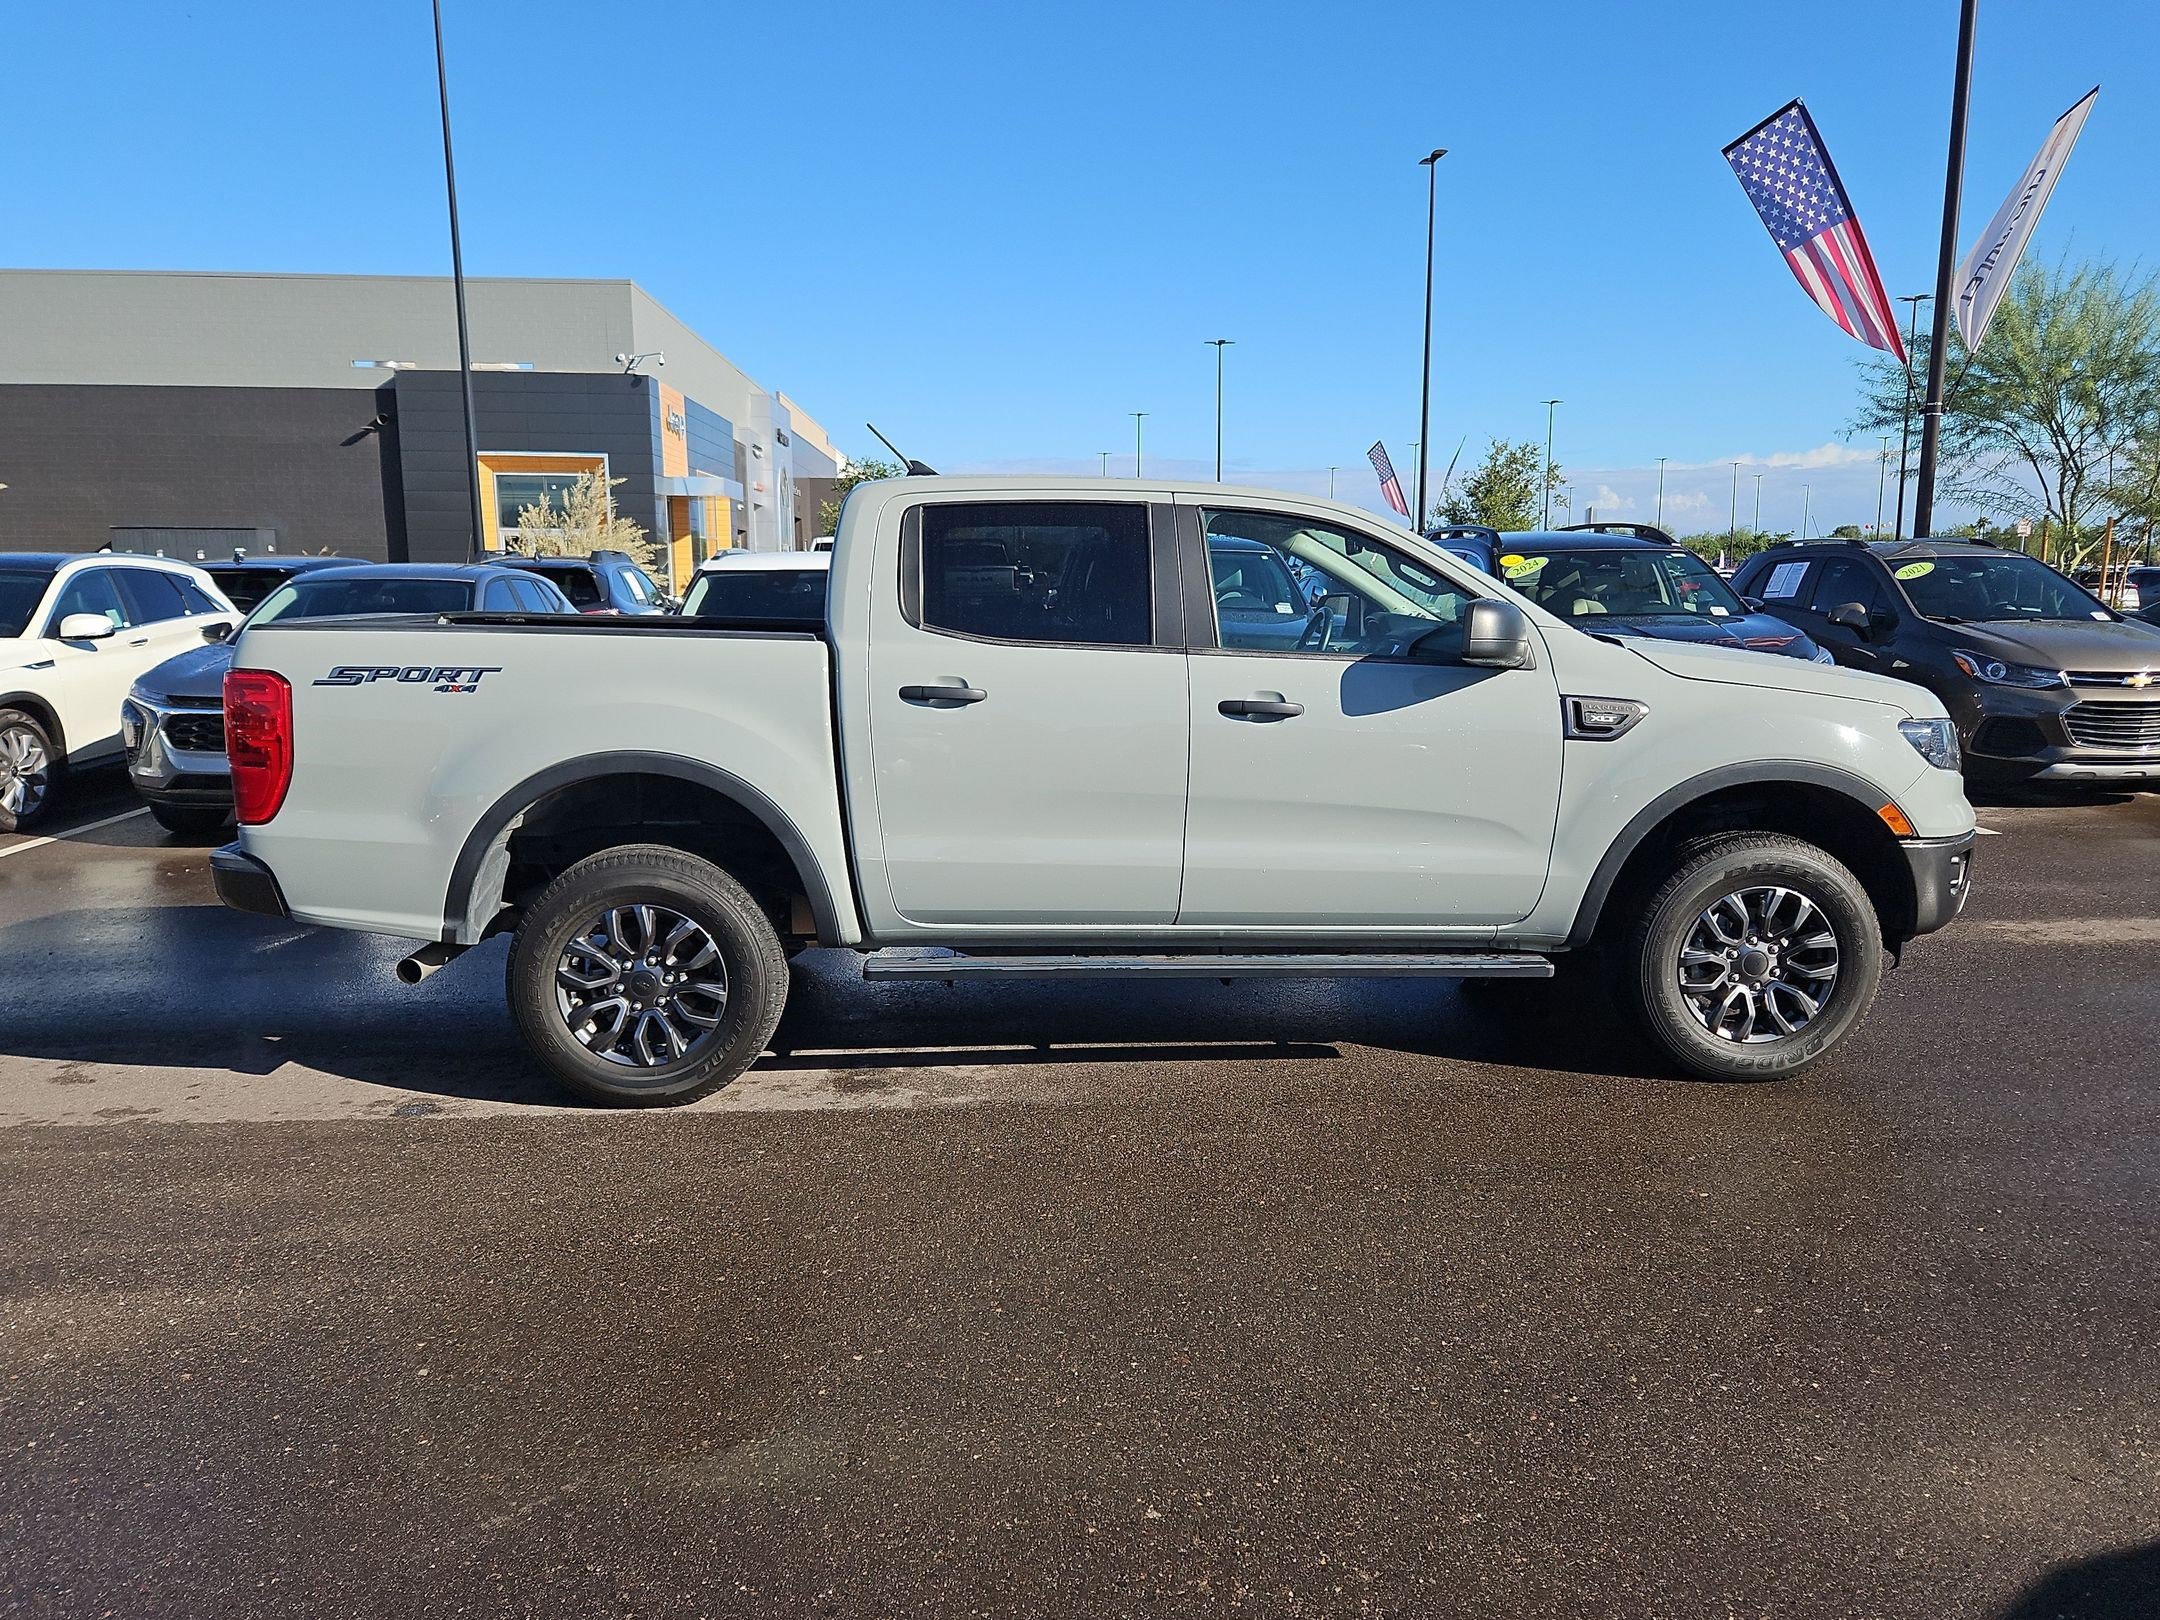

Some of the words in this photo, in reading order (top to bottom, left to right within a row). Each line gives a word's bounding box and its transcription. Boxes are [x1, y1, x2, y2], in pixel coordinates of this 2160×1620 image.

[1960, 169, 2047, 306] CHOLET
[1513, 559, 1540, 576] 2024
[1901, 564, 1928, 578] 2021
[312, 666, 503, 686] SPORT
[1590, 714, 1618, 722] XLT
